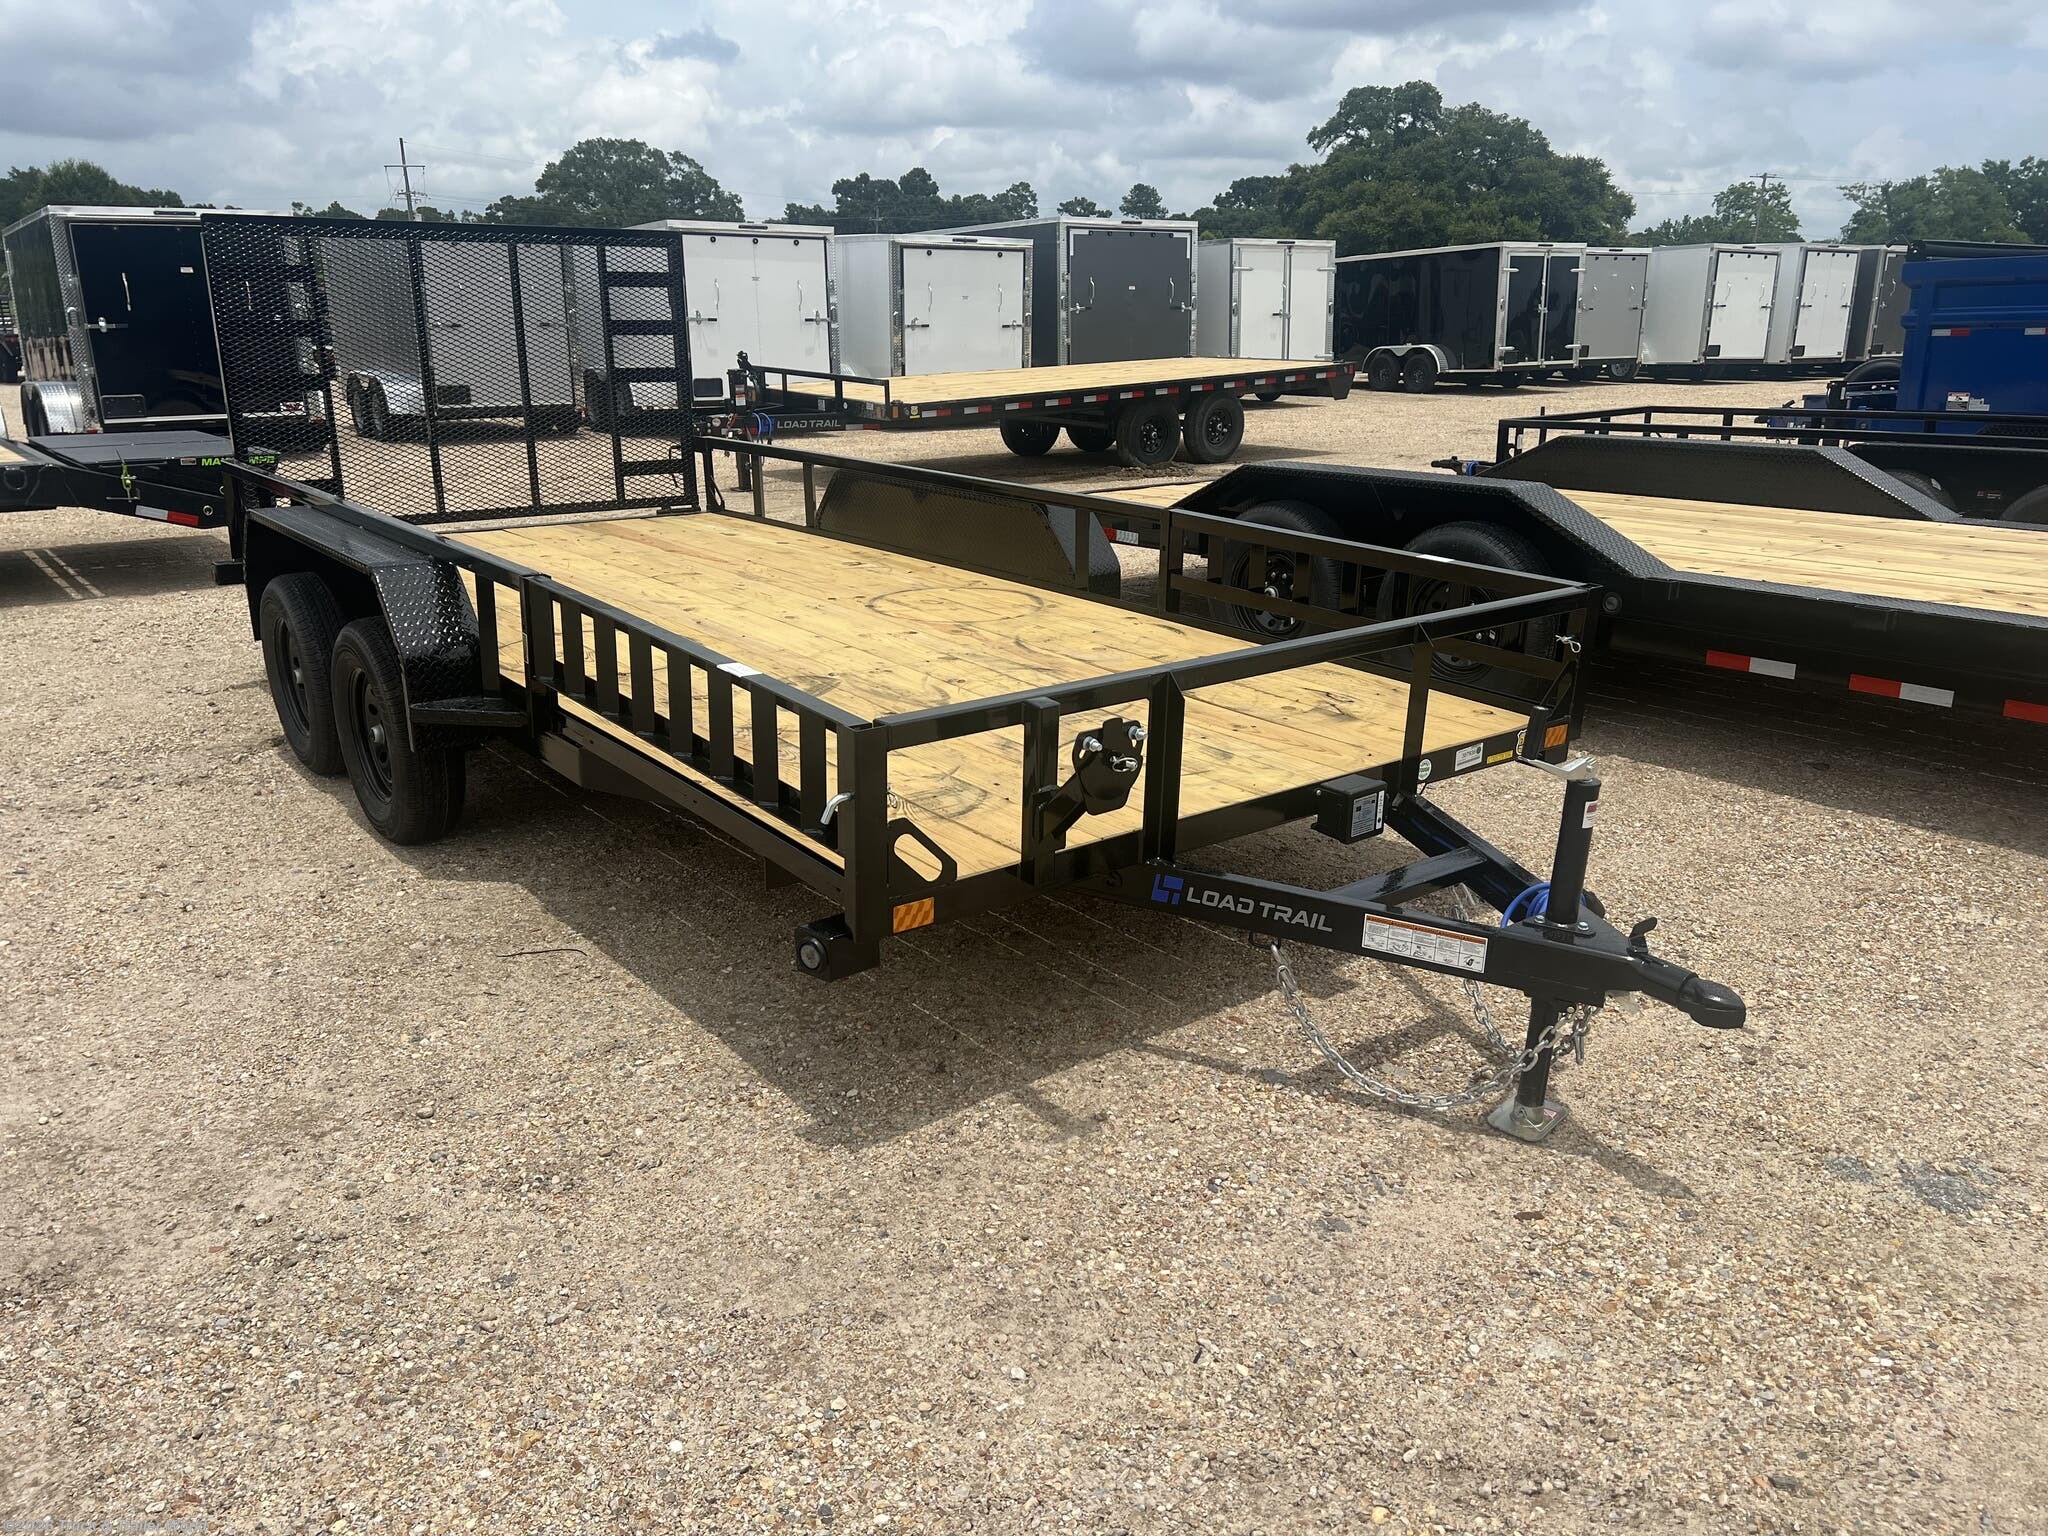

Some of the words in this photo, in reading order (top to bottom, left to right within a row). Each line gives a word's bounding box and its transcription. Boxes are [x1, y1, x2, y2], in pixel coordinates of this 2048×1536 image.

[809, 420, 840, 428] TRAIL
[1186, 887, 1255, 915] LOAD
[1259, 901, 1333, 933] TRAIL
